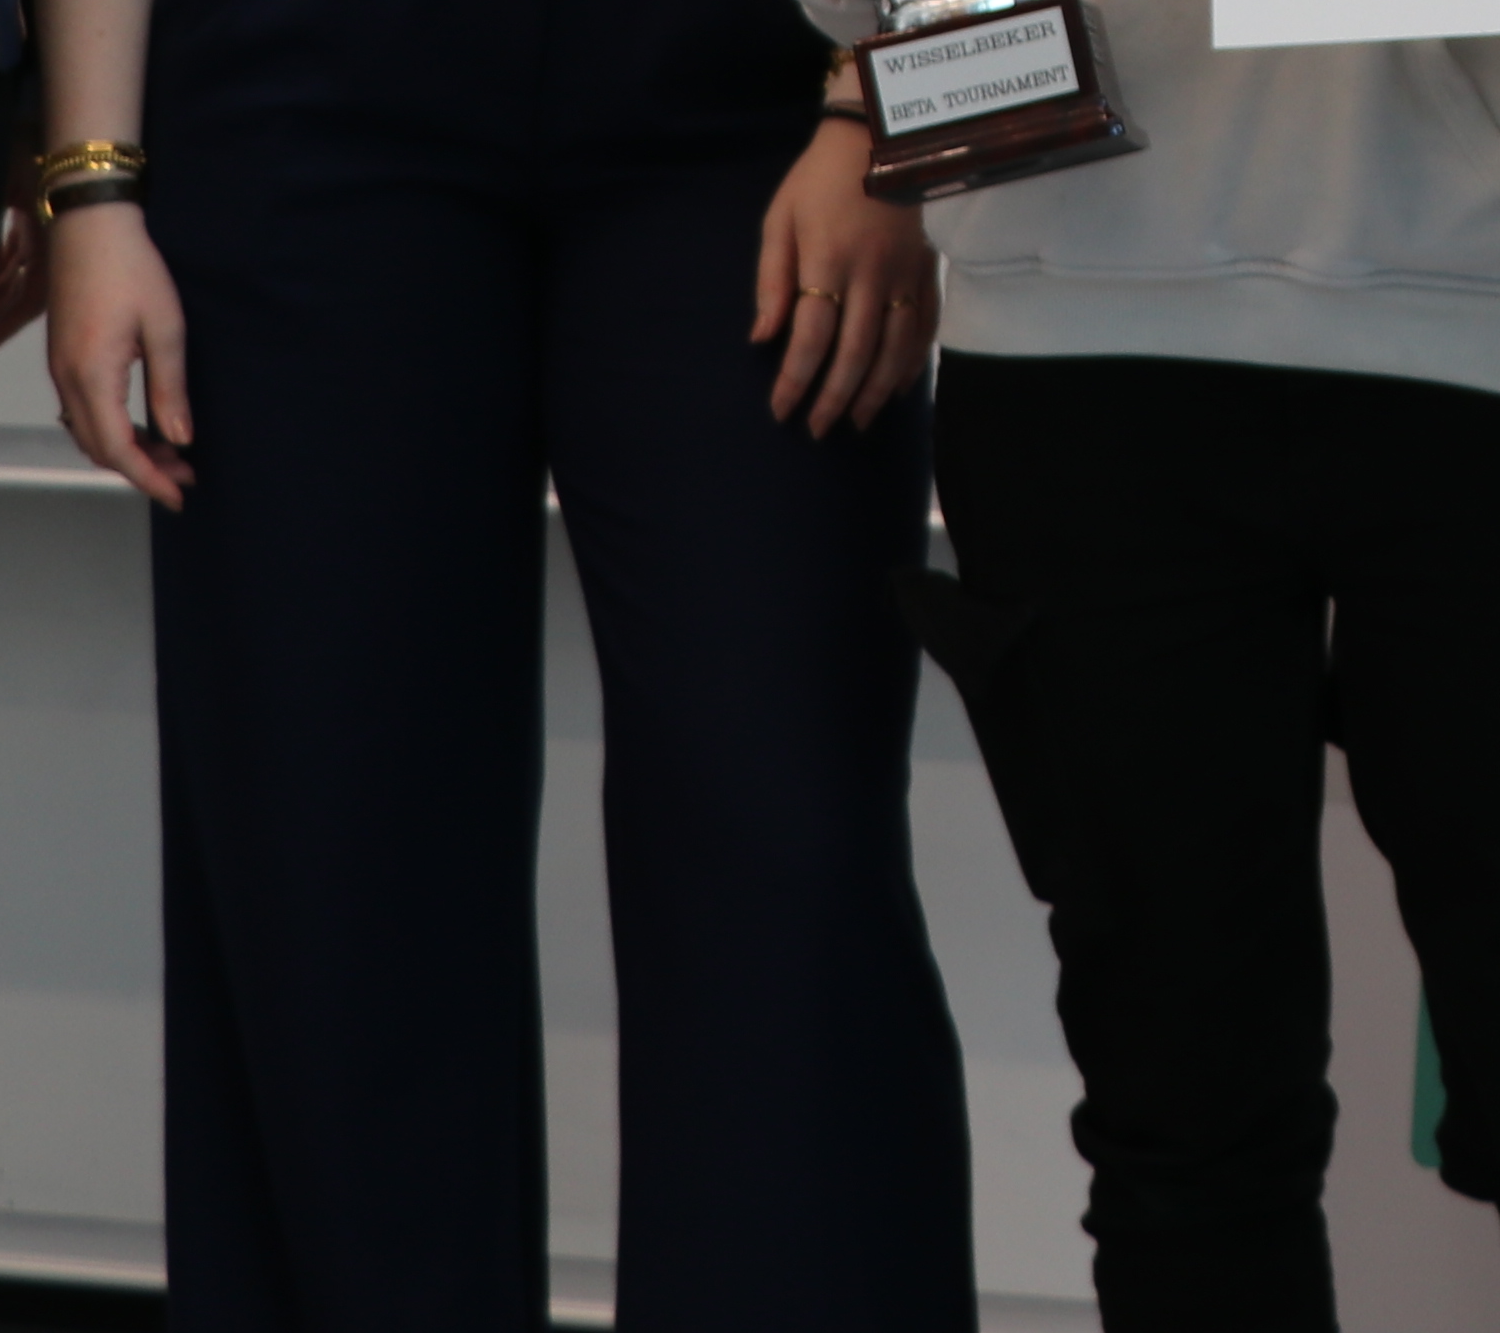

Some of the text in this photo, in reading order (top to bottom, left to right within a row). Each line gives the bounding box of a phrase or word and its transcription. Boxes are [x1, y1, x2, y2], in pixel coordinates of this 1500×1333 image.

[884, 21, 1056, 75] WISSELBEKER
[891, 64, 1069, 121] BETA TOURNAMENT
